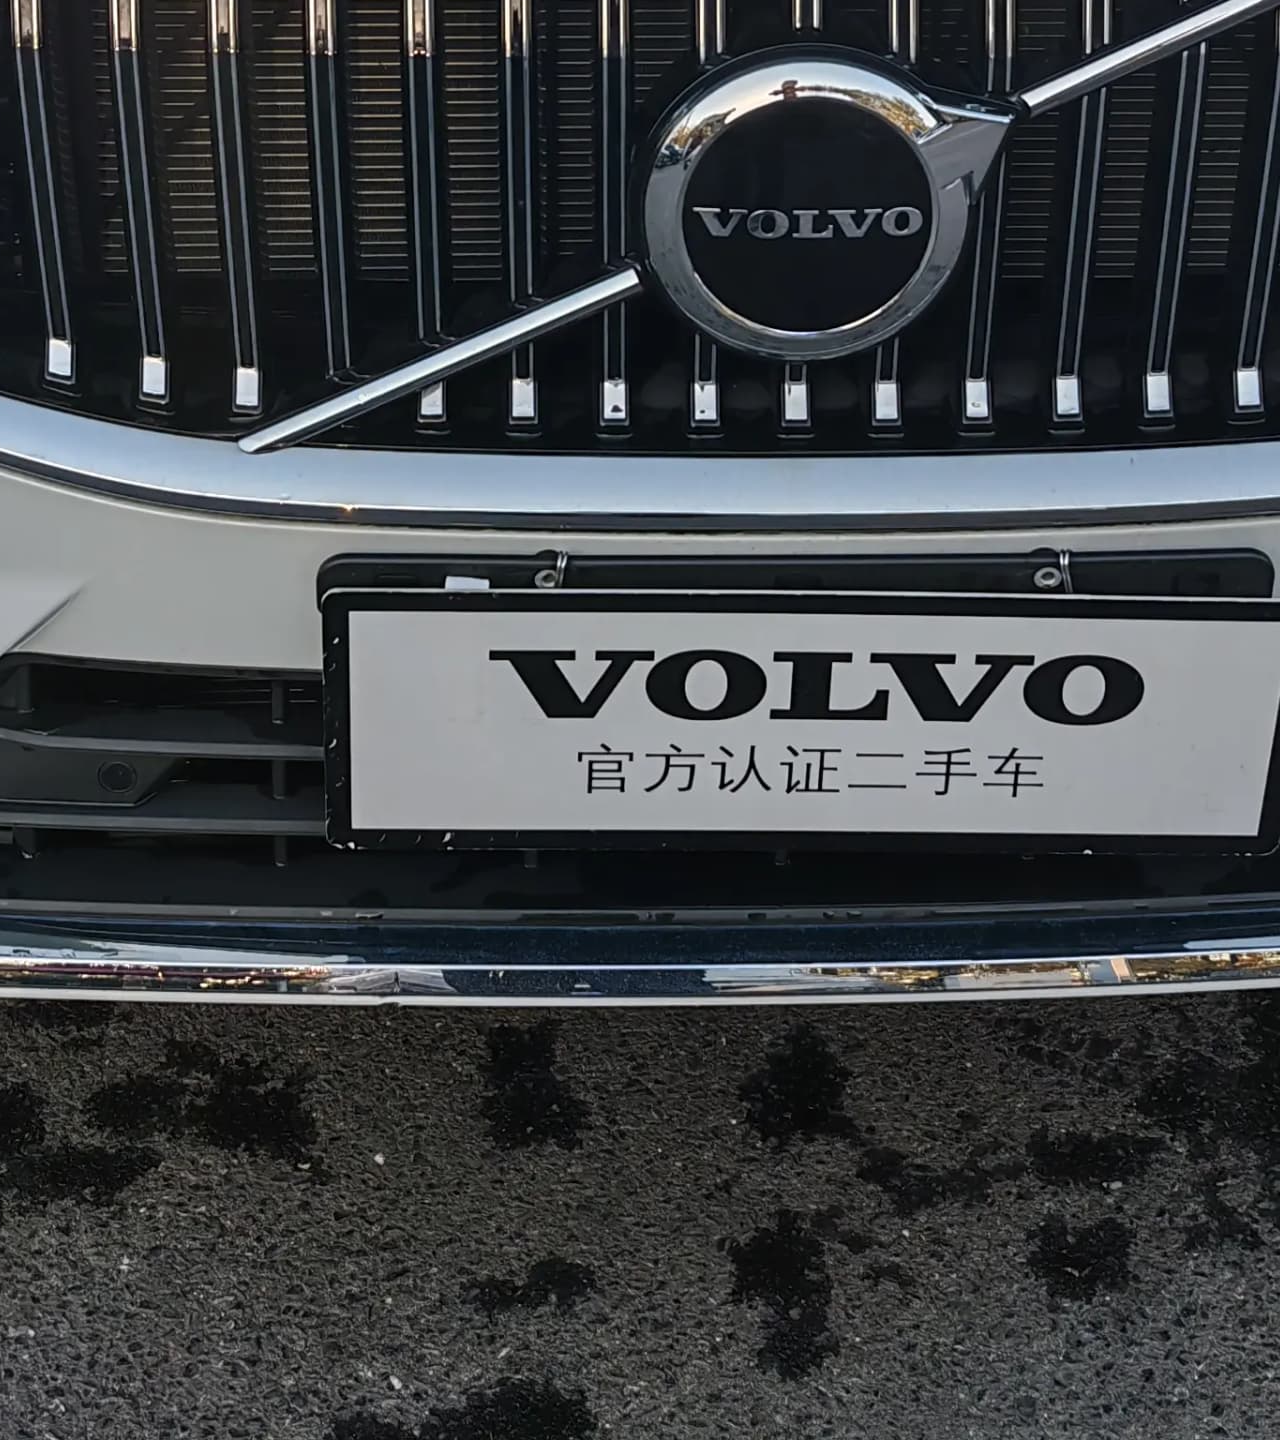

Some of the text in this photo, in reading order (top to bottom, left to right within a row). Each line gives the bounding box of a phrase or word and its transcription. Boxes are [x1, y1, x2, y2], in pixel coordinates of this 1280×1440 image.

[692, 206, 924, 240] VOLVO
[488, 649, 1145, 726] VOLVO
[577, 743, 1045, 799] 官方认证二手车
